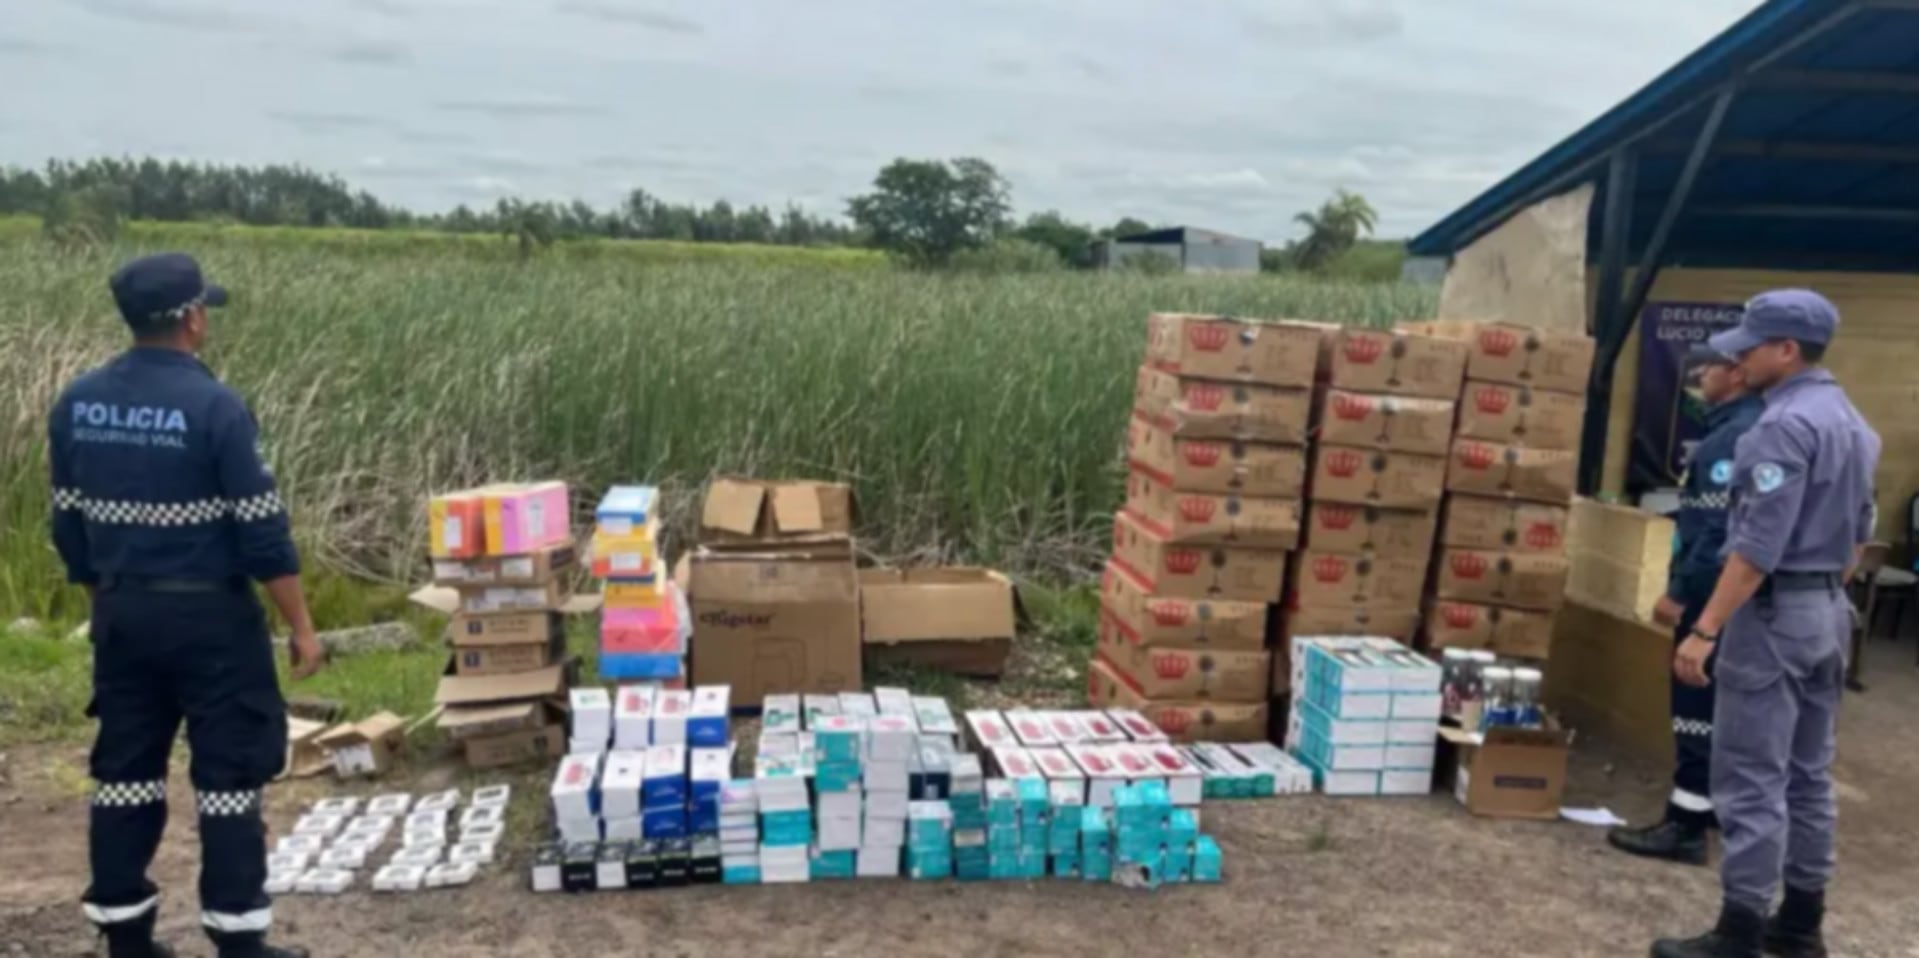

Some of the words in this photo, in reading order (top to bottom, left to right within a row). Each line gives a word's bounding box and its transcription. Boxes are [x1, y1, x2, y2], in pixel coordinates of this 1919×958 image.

[1661, 308, 1743, 322] DELEGACI
[1656, 326, 1704, 340] LUCIO
[73, 401, 187, 432] POLICIA
